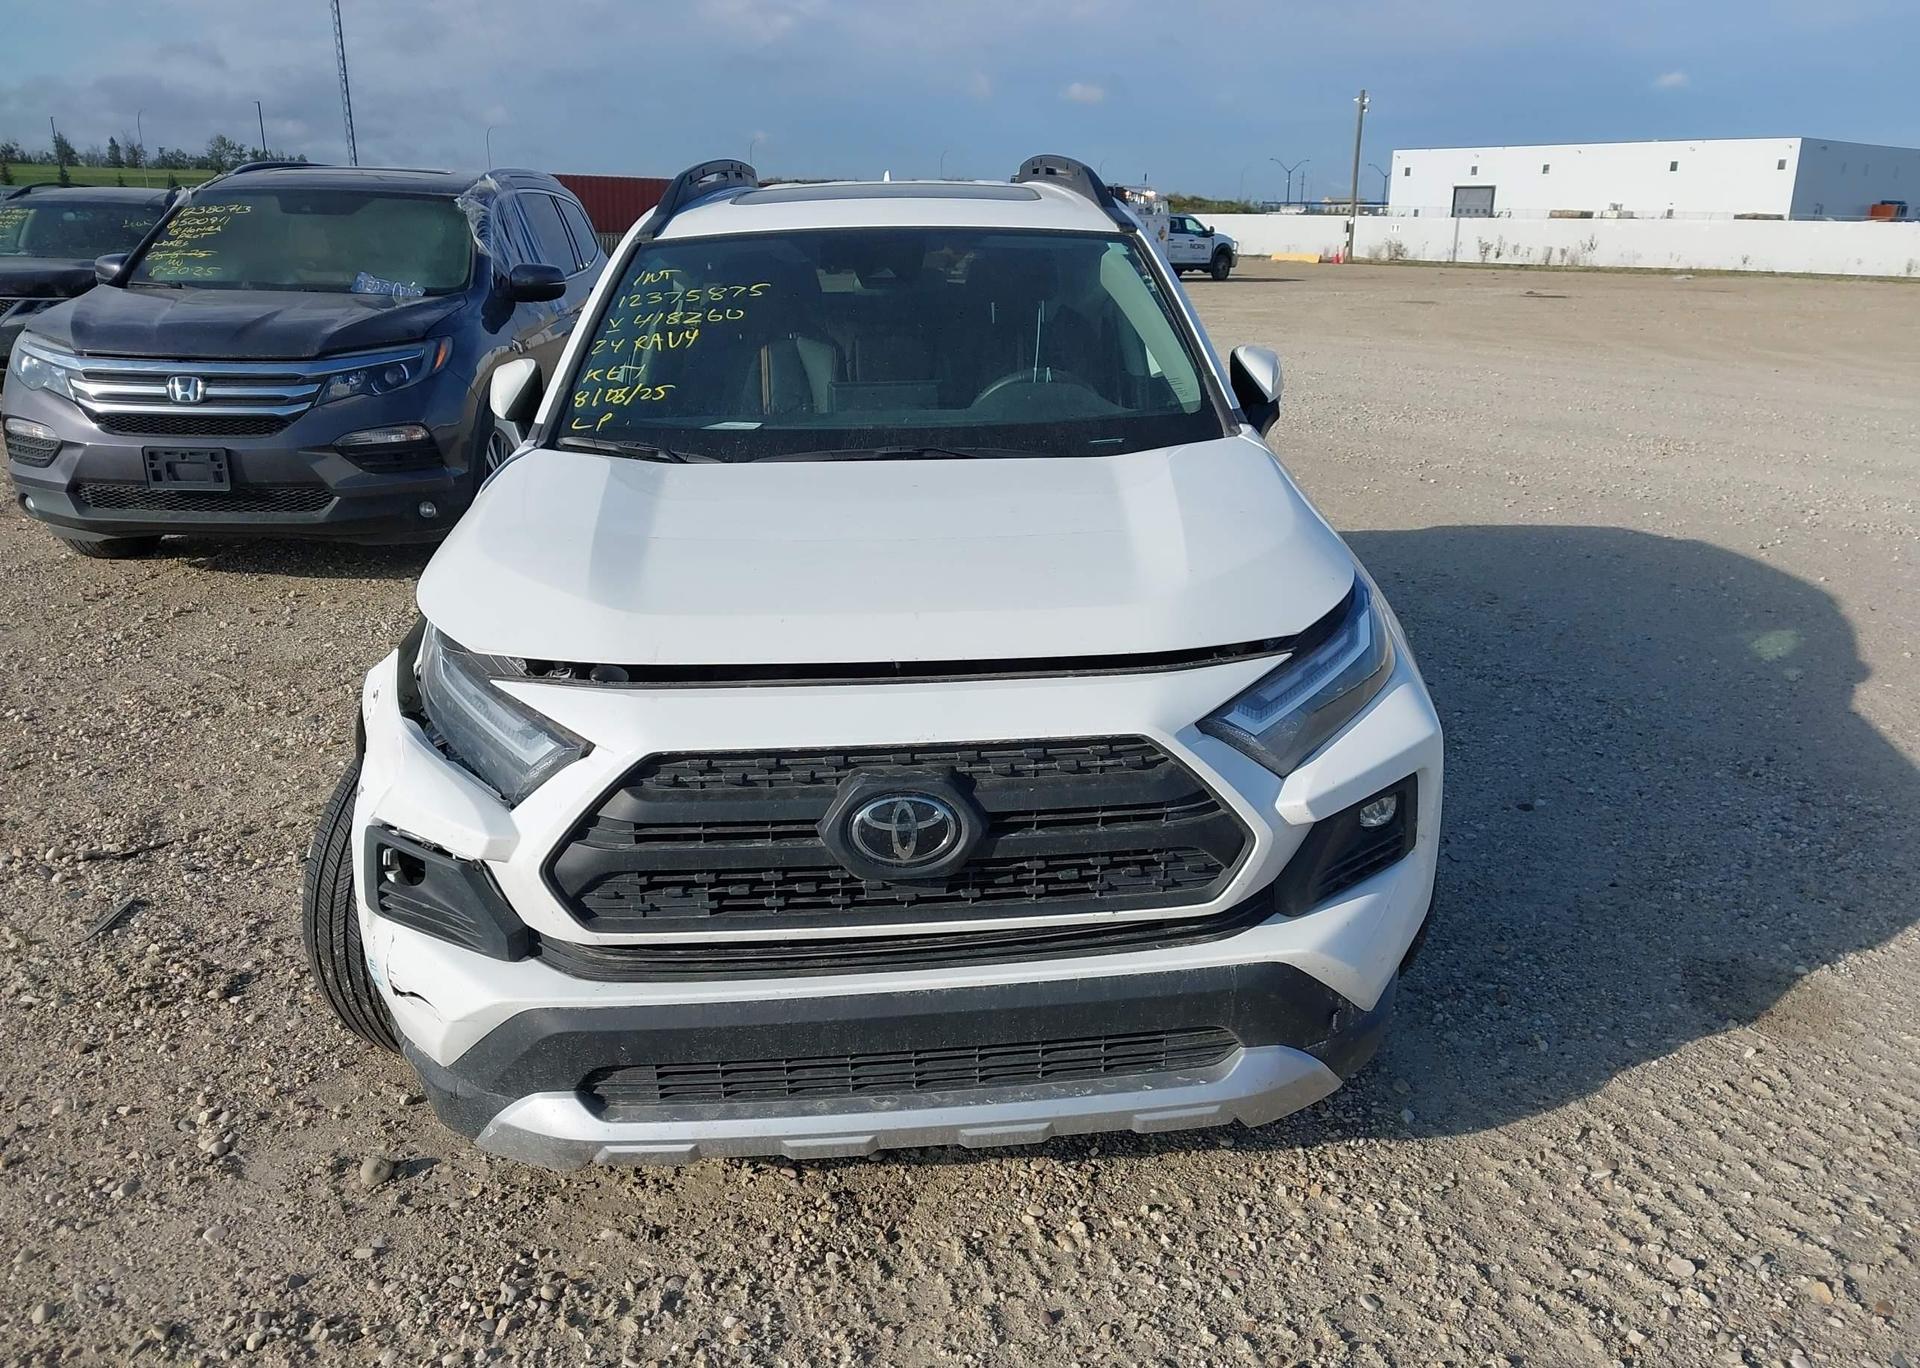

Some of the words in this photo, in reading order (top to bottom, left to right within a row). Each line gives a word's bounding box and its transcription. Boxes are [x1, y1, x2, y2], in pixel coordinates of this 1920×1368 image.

[618, 282, 771, 308] 12375875
[633, 308, 745, 329] 418260
[591, 338, 625, 355] 24
[635, 328, 699, 352] RAV4
[571, 412, 613, 431] LP
